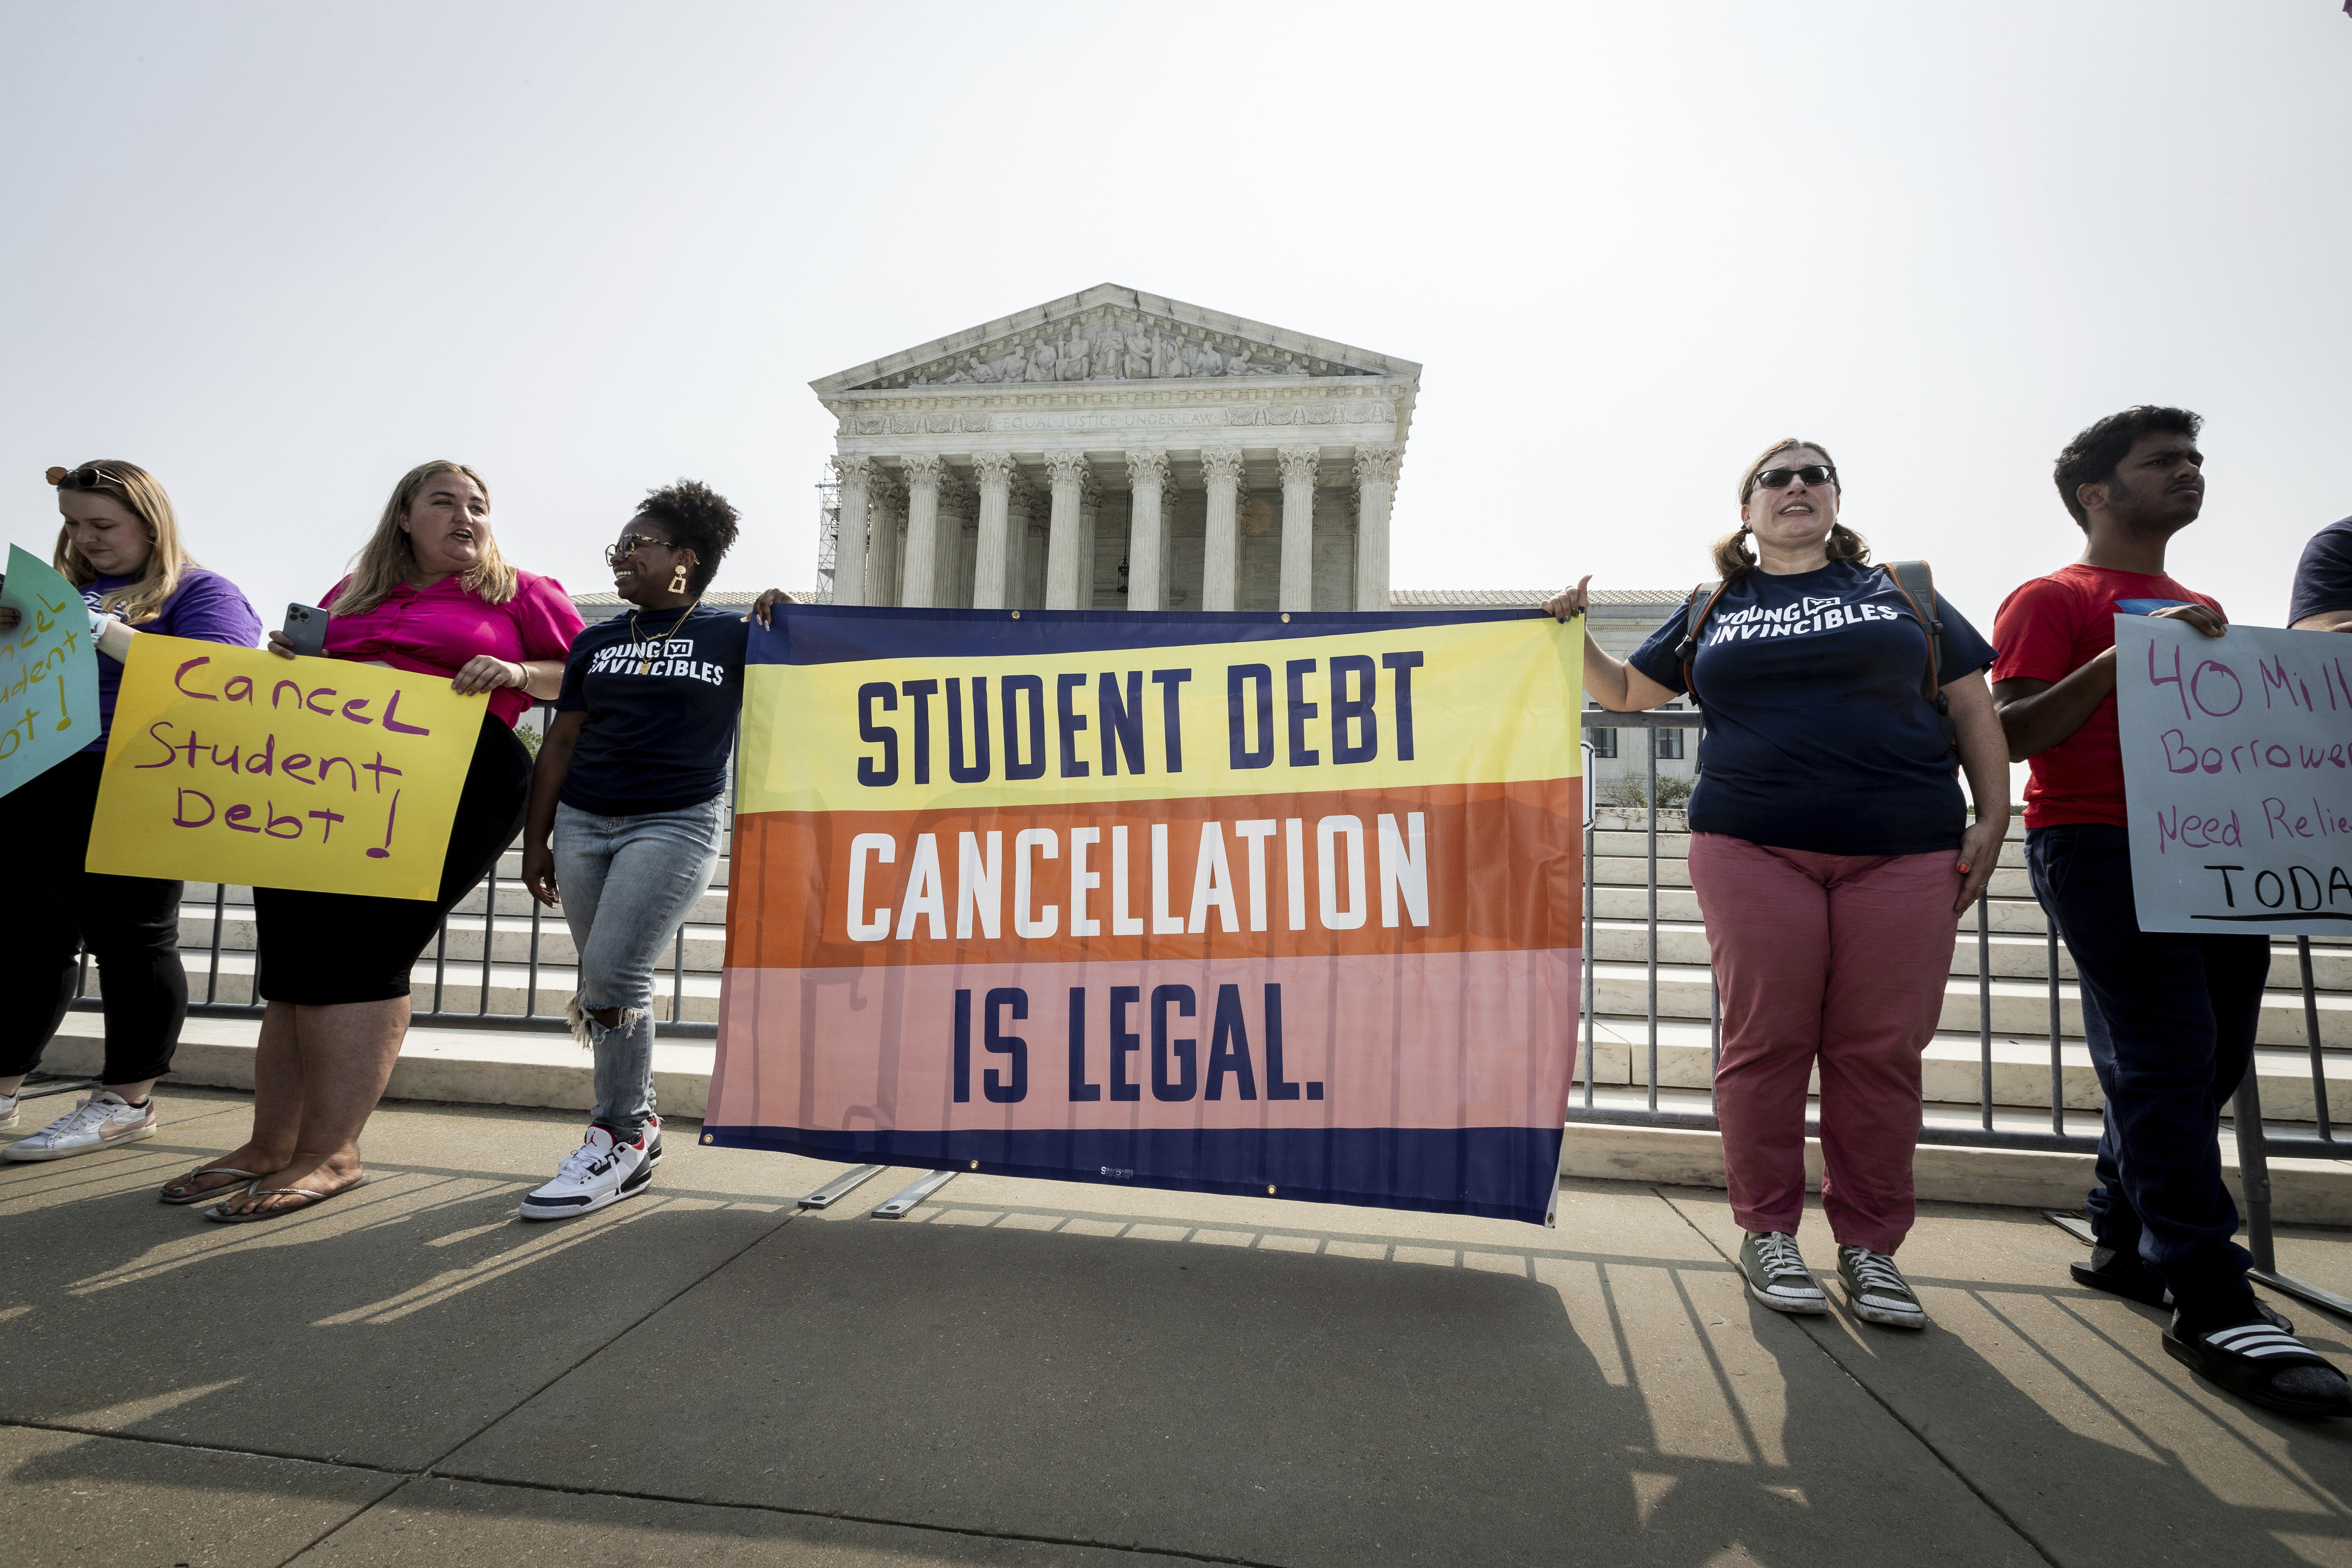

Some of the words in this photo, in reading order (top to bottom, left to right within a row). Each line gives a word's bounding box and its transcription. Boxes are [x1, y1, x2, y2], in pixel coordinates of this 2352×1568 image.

[1004, 417, 1054, 429] EQUAL
[1057, 415, 1117, 427] JUSTICE
[1125, 413, 1176, 425] UNDER
[1182, 413, 1213, 424] LAW
[1710, 604, 1898, 646] INVINCIBLES
[1717, 603, 1799, 625] YOUNG
[587, 659, 724, 686] INVINCIBLES
[593, 642, 661, 664] YOUNG
[669, 644, 686, 653] YI
[2149, 639, 2243, 720] 40
[858, 668, 1192, 787] STUDENT
[1227, 651, 1424, 770] DEBT
[134, 721, 402, 794] Student
[2157, 805, 2243, 854] Need
[2262, 797, 2352, 840] Relie
[846, 812, 1429, 942] CANCELLATION
[953, 987, 1028, 1103] IS
[1068, 983, 1324, 1102] LEGAL.
